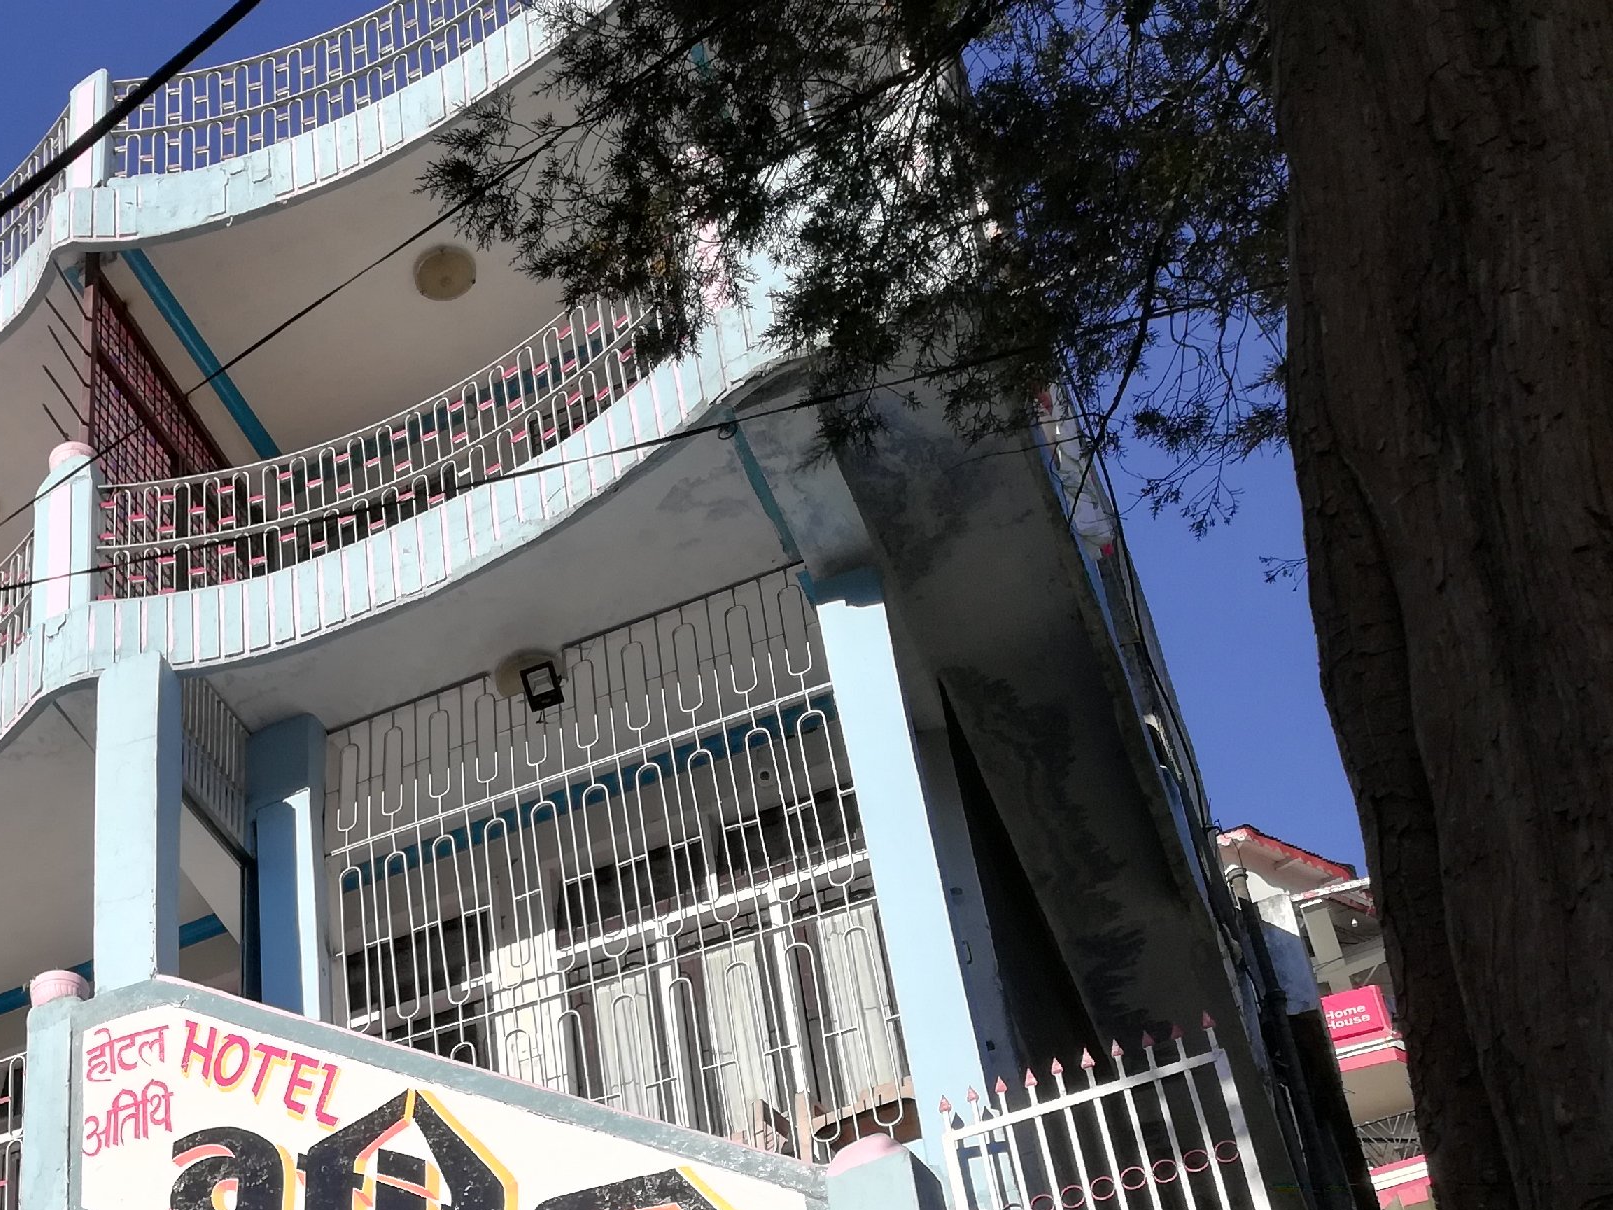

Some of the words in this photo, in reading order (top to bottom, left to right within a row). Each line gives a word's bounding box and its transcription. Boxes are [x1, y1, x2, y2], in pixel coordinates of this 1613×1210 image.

[85, 1027, 170, 1082] होटल
[181, 1019, 341, 1130] HOTEL
[82, 1078, 174, 1157] अतिथि
